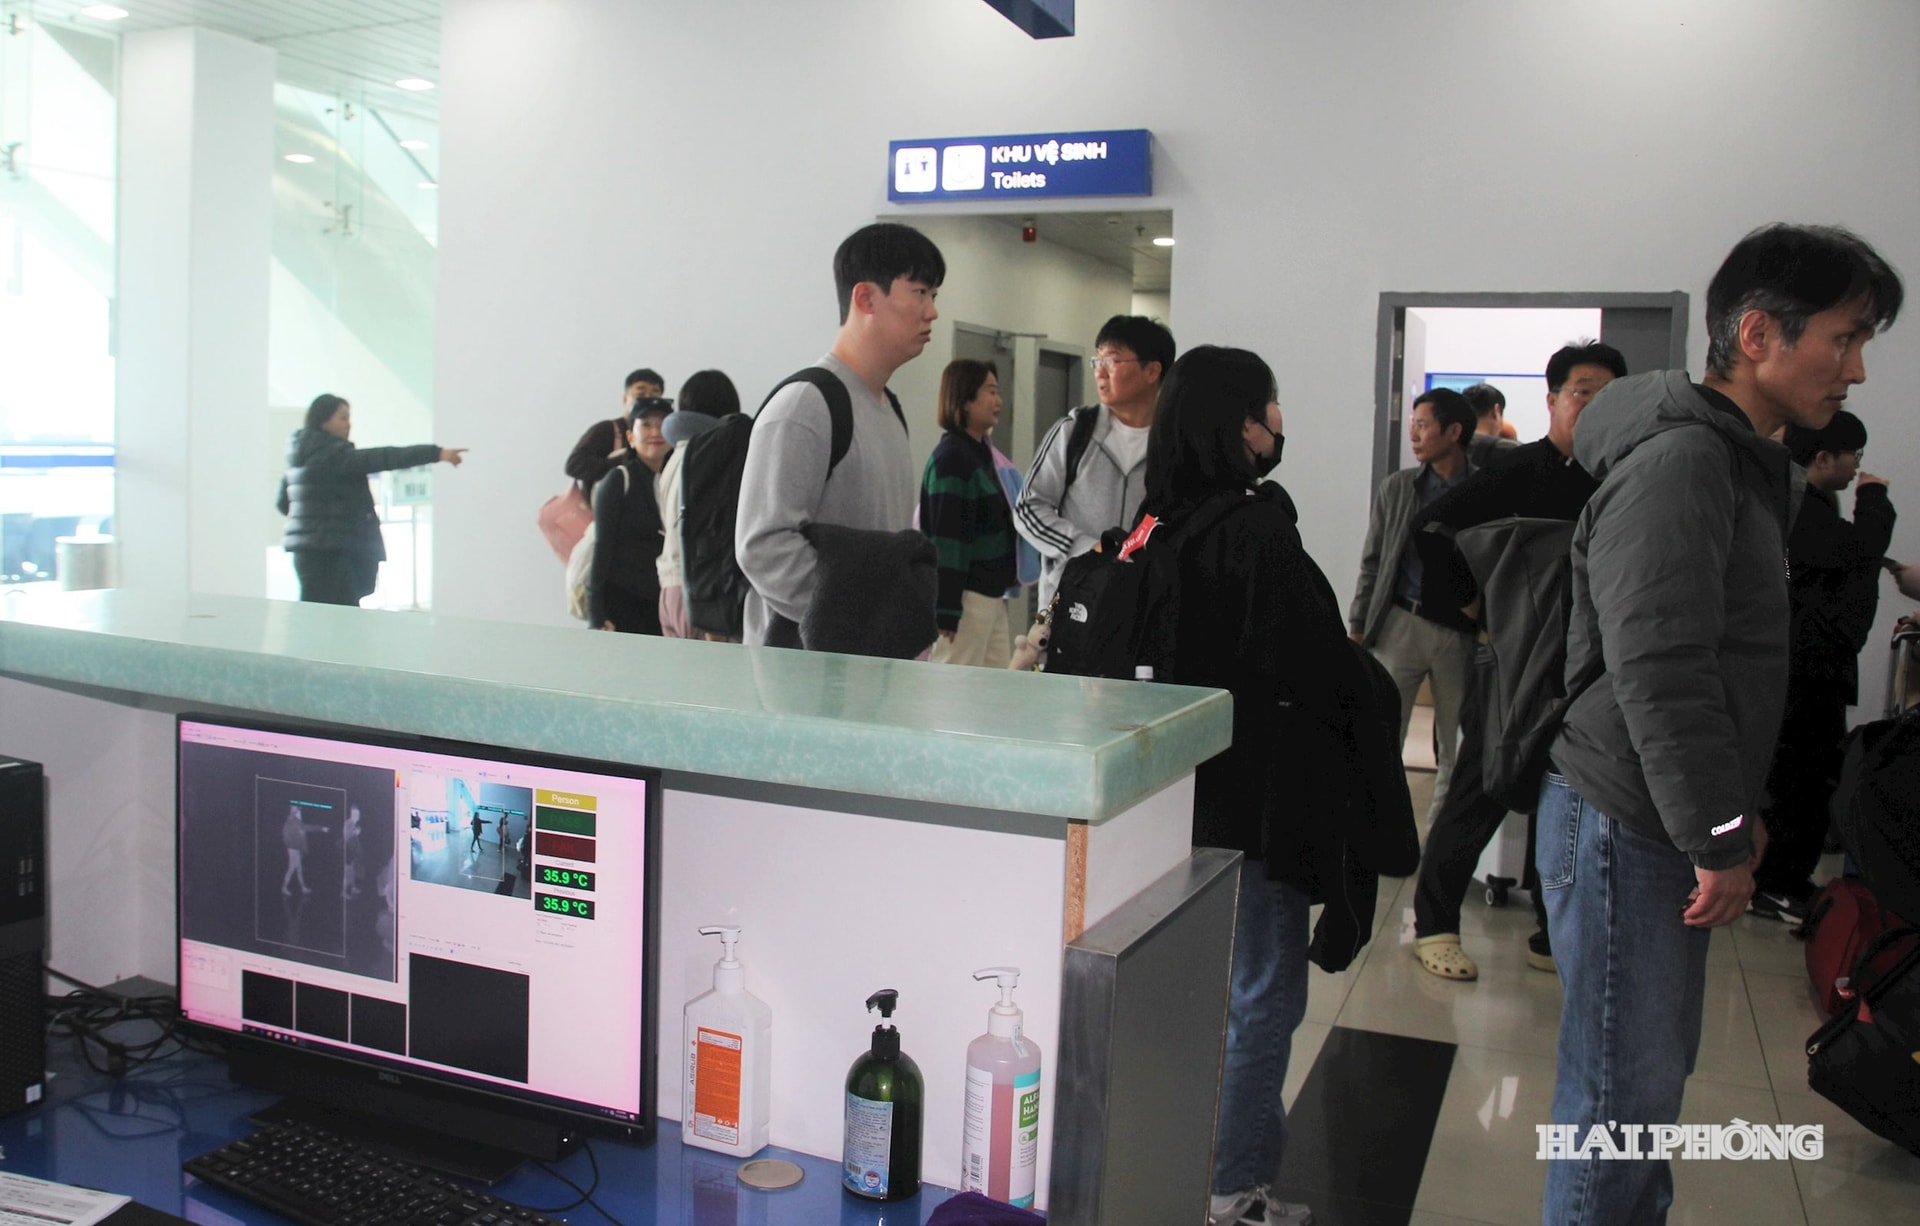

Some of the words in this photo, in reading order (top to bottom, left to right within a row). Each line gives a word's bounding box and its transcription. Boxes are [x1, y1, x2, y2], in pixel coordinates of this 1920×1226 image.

[991, 145, 1032, 163] KHU
[1034, 140, 1059, 165] VỆ
[1060, 142, 1107, 161] SINH
[991, 171, 1047, 189] Toilets
[551, 793, 580, 806] Person
[543, 869, 570, 884] 35.9
[573, 873, 588, 887] °C
[543, 897, 570, 912] 35.9
[572, 901, 588, 915] °C
